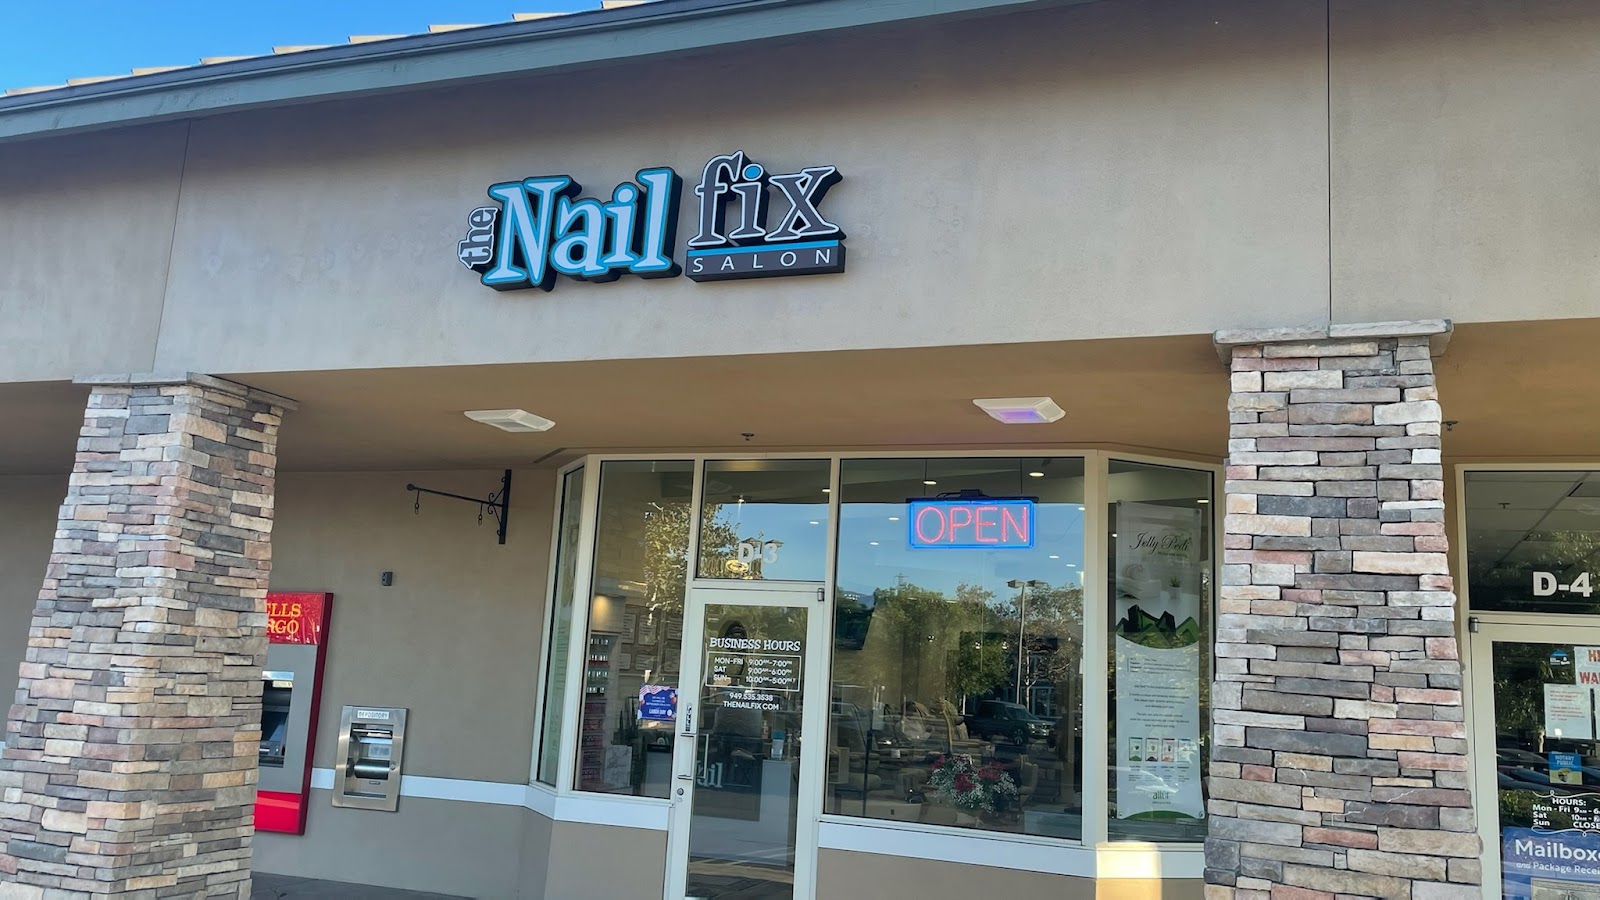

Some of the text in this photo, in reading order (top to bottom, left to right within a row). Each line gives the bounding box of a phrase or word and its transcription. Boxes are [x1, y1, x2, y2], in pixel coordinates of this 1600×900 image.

[458, 150, 840, 287] the Nail fix
[691, 248, 832, 273] SALON
[916, 506, 1028, 543] OPEN
[1129, 531, 1190, 555] Jelly Pedi
[738, 542, 778, 564] D-3
[1532, 571, 1594, 598] D-4
[709, 637, 801, 652] BUSINESS HOURS
[714, 657, 744, 665] MON-FRI
[722, 700, 780, 711] THENAILFIXCOM
[1532, 804, 1553, 812] Mon
[1558, 805, 1571, 813] Fri
[1552, 797, 1587, 807] HOURS:
[1533, 811, 1548, 819] Sat
[1533, 818, 1551, 827] Sun
[1515, 839, 1600, 862] Mailbox
[1533, 861, 1572, 874] Package
